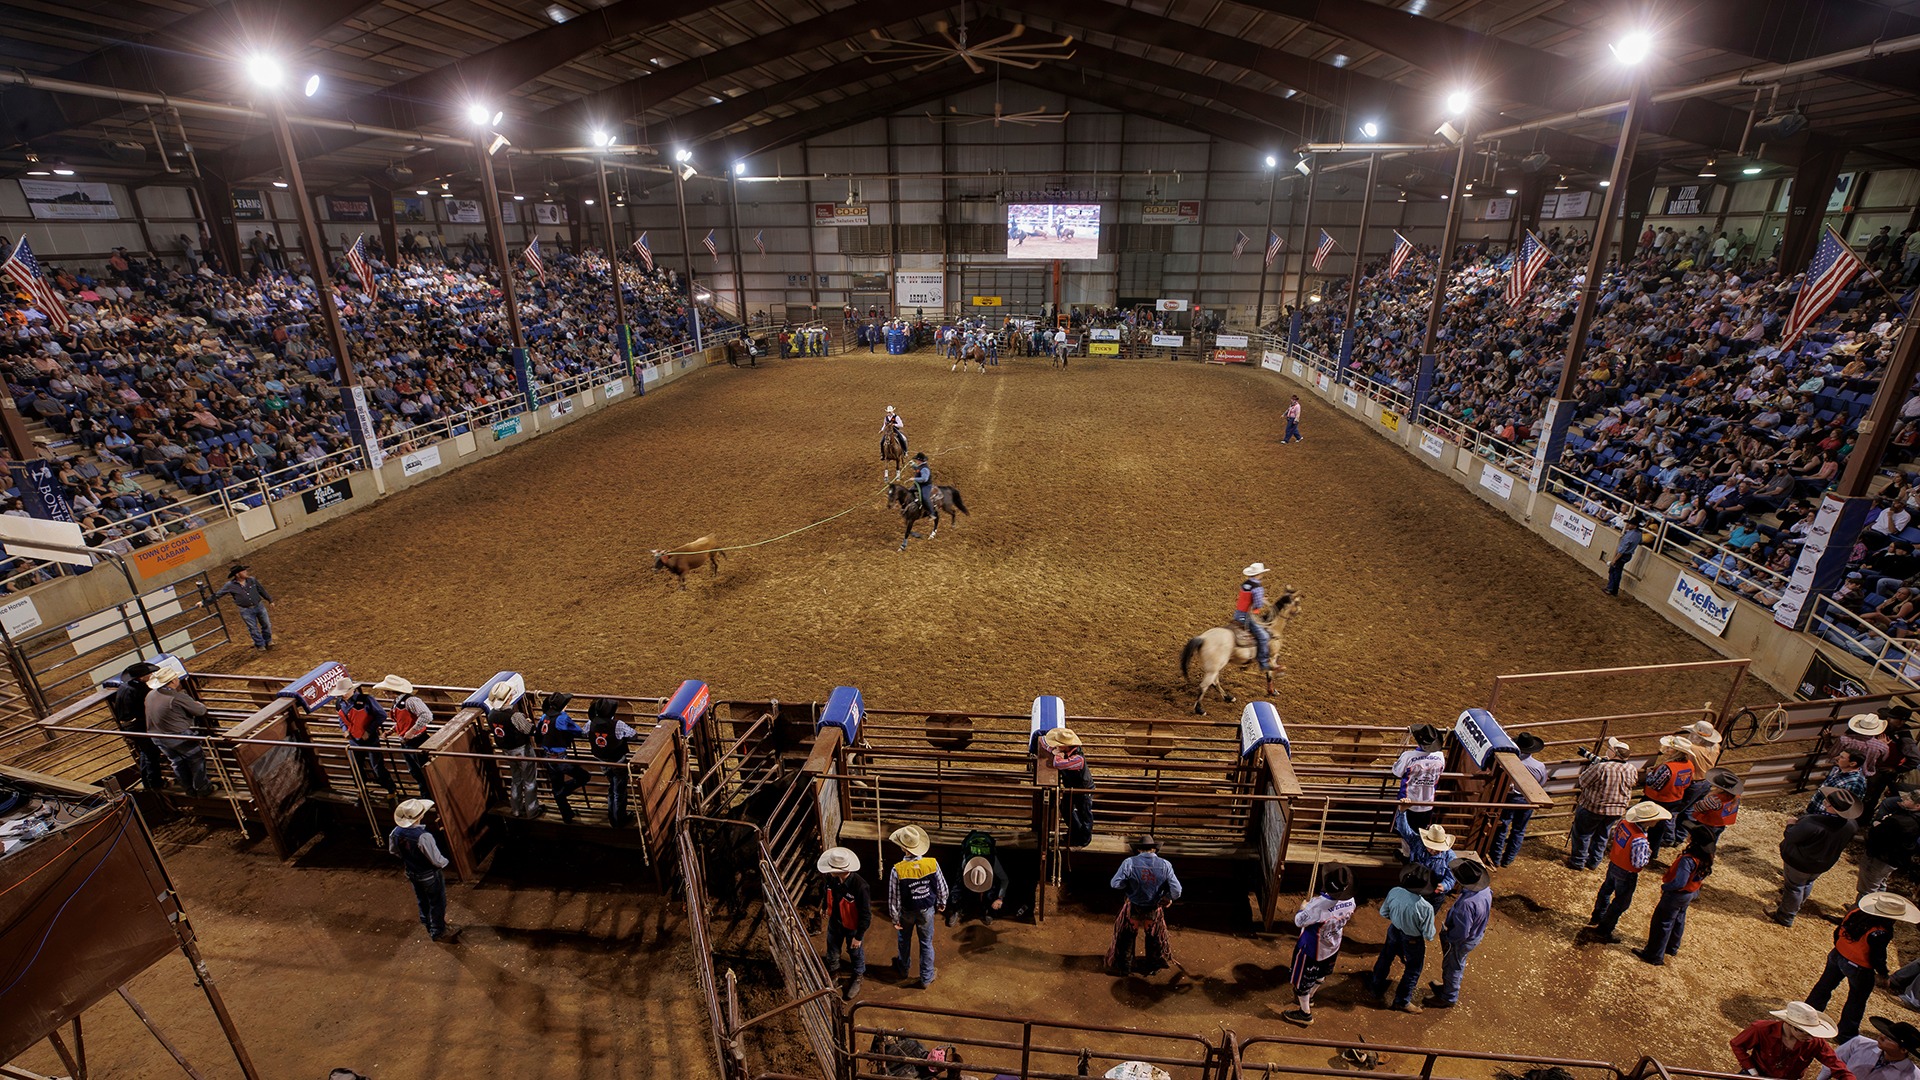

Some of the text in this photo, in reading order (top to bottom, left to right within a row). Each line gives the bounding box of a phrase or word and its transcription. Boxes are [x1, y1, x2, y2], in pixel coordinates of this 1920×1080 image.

[238, 199, 262, 209] FARMS
[1144, 206, 1177, 214] CO-OP
[836, 208, 867, 216] CO-OP
[138, 548, 160, 561] TOWN
[160, 544, 170, 553] OF
[170, 533, 201, 549] COALING
[156, 545, 190, 562] ALABAMA
[8, 600, 28, 612] Horses
[1677, 578, 1729, 620] Priefert
[314, 665, 343, 687] HUDDLE
[1462, 715, 1488, 748] MOON
[1327, 901, 1353, 913] WEBER
